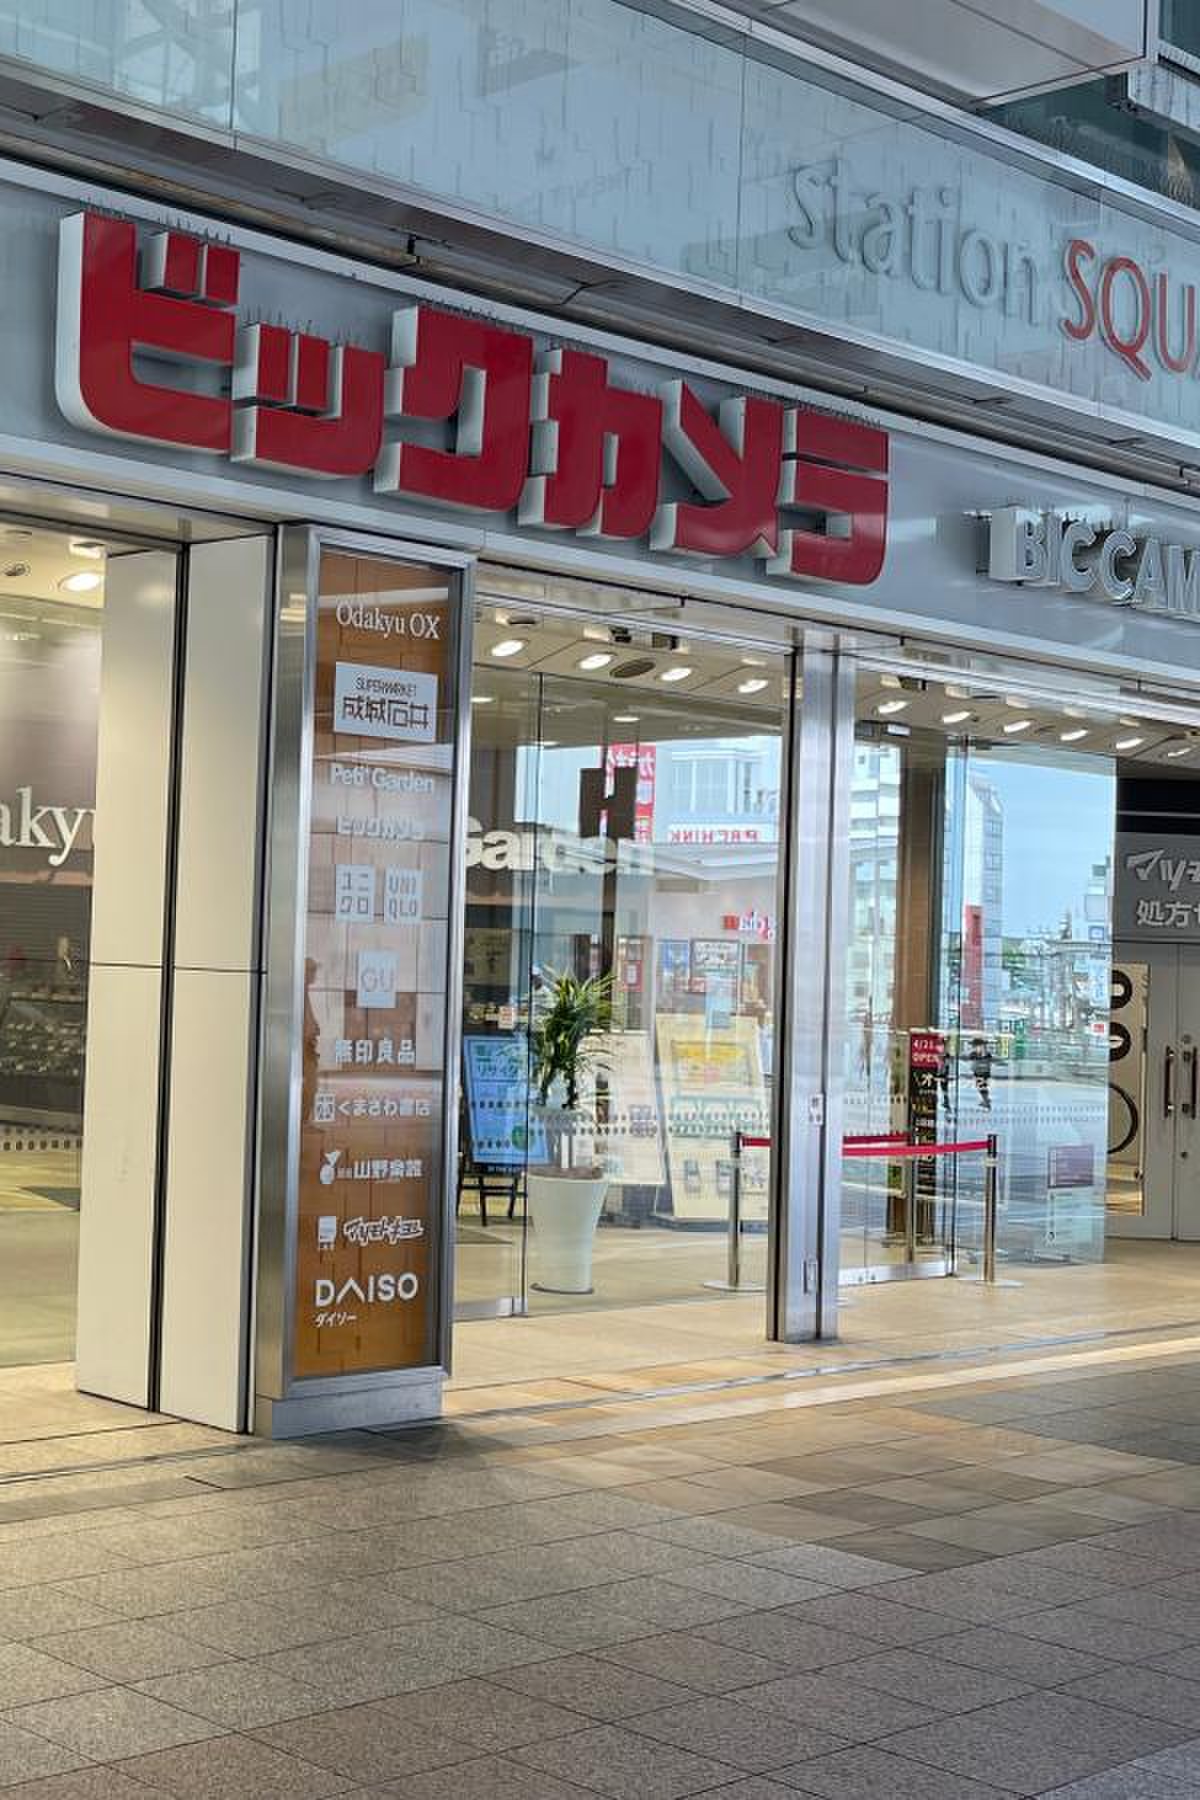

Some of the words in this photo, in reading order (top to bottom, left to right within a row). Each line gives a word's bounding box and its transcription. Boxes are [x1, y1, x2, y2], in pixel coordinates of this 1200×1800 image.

[787, 159, 1039, 328] Station
[1062, 239, 1200, 382] SQU
[56, 209, 890, 586] ビックカメラ
[336, 602, 404, 638] Odakyu
[410, 613, 440, 639] OX
[342, 695, 429, 729] 成城石井
[372, 767, 433, 793] Garden
[336, 1039, 416, 1064] 無印良品
[338, 1098, 431, 1117] くまさわ書店
[315, 1272, 419, 1307] DAISO
[314, 1311, 358, 1328] ダイソー
